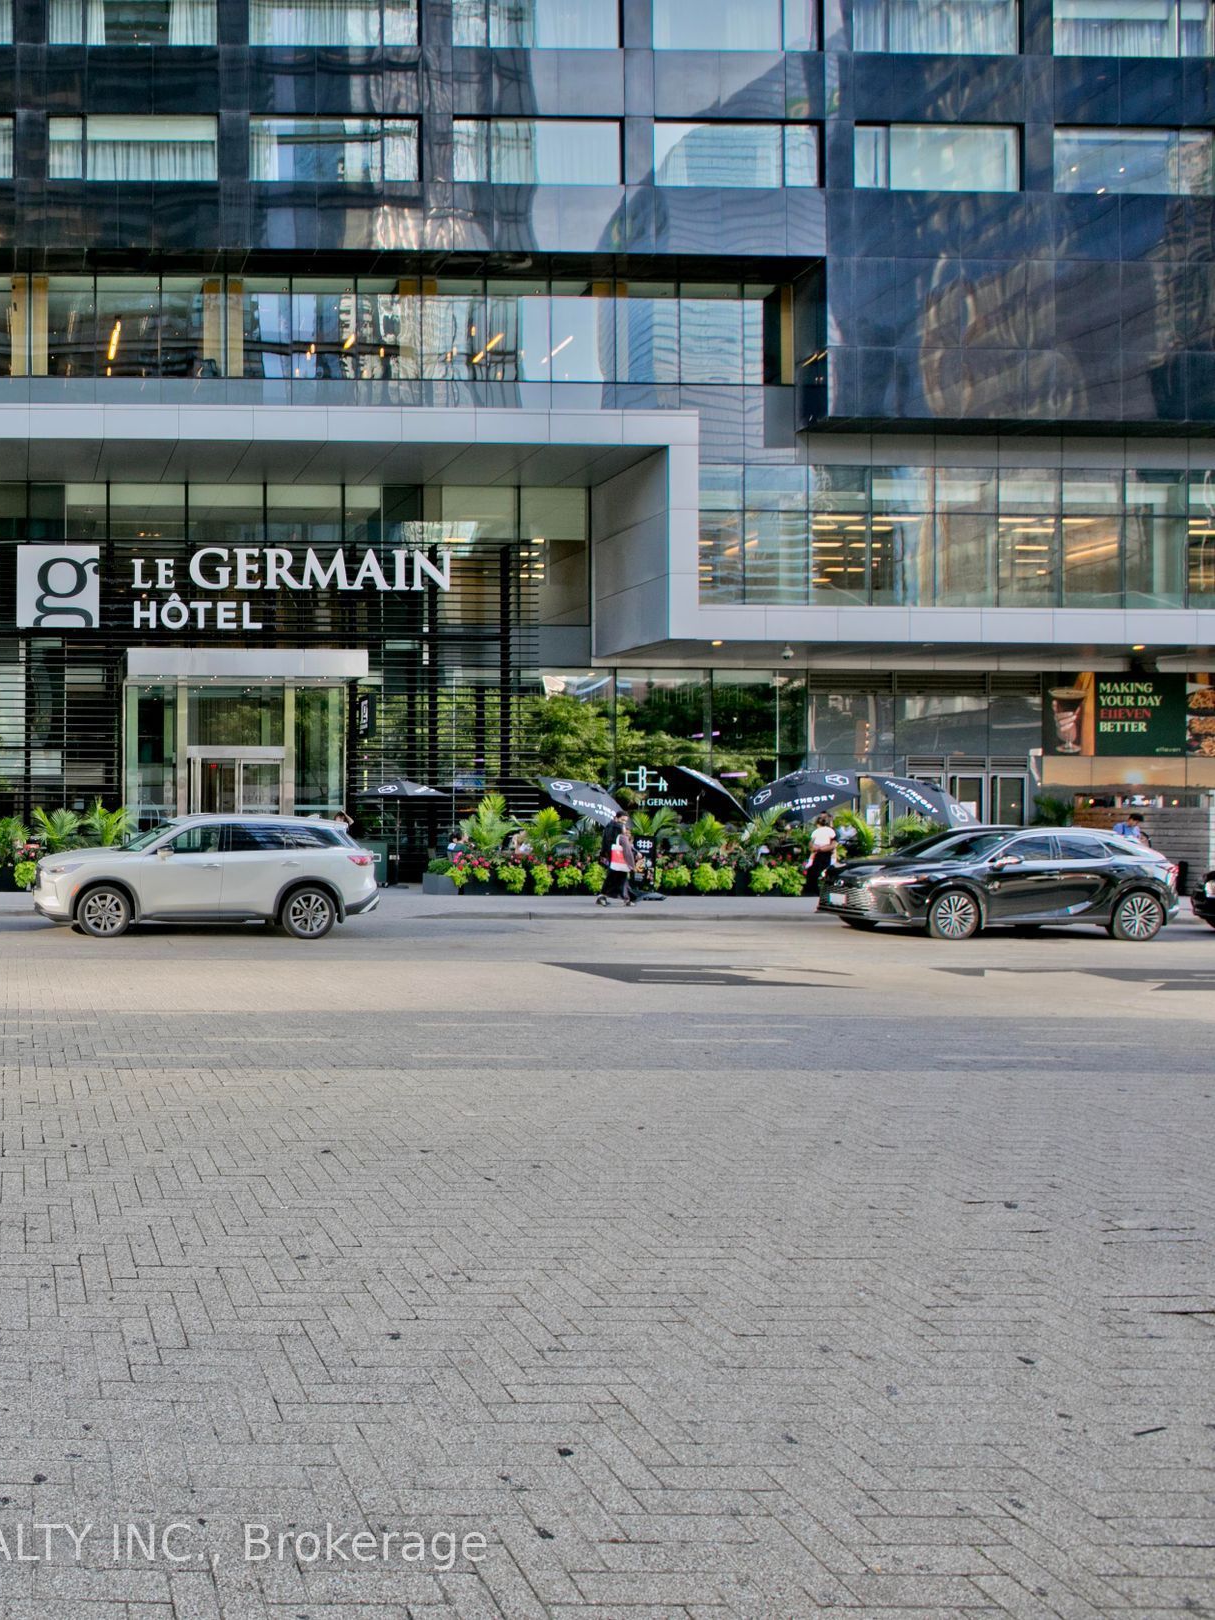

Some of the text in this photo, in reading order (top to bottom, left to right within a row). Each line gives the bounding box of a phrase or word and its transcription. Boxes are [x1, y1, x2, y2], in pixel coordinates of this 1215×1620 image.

[131, 547, 453, 592] LE GERMAIN
[133, 593, 263, 631] HÔTEL
[1098, 682, 1153, 694] MAKING
[1098, 695, 1163, 707] YOUR DAY
[1098, 721, 1148, 733] BETTER
[646, 798, 688, 806] GERMAIN
[793, 794, 835, 805] THEORY
